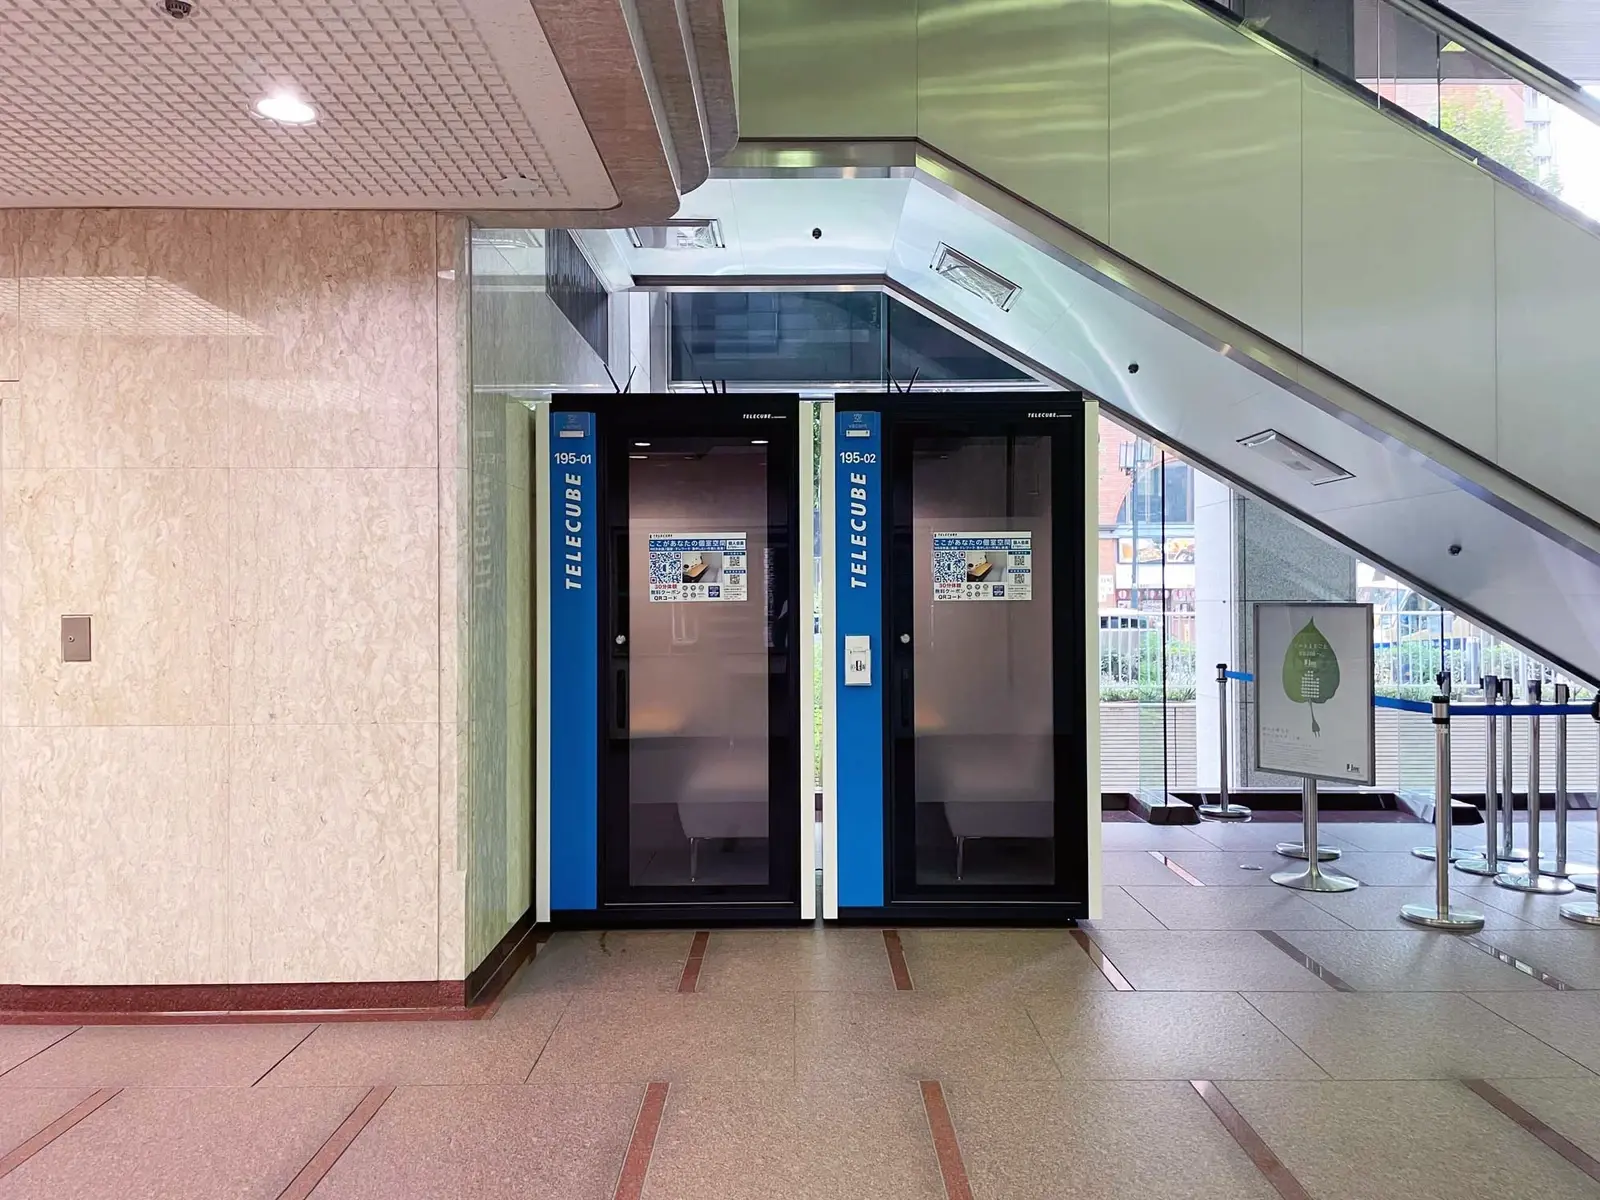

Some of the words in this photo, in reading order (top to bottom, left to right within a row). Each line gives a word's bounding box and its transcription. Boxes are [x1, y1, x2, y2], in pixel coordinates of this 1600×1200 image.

[554, 452, 592, 465] 195-01
[839, 451, 876, 464] 195-02
[565, 473, 582, 590] TELECUBE
[850, 472, 867, 588] TELECUBE
